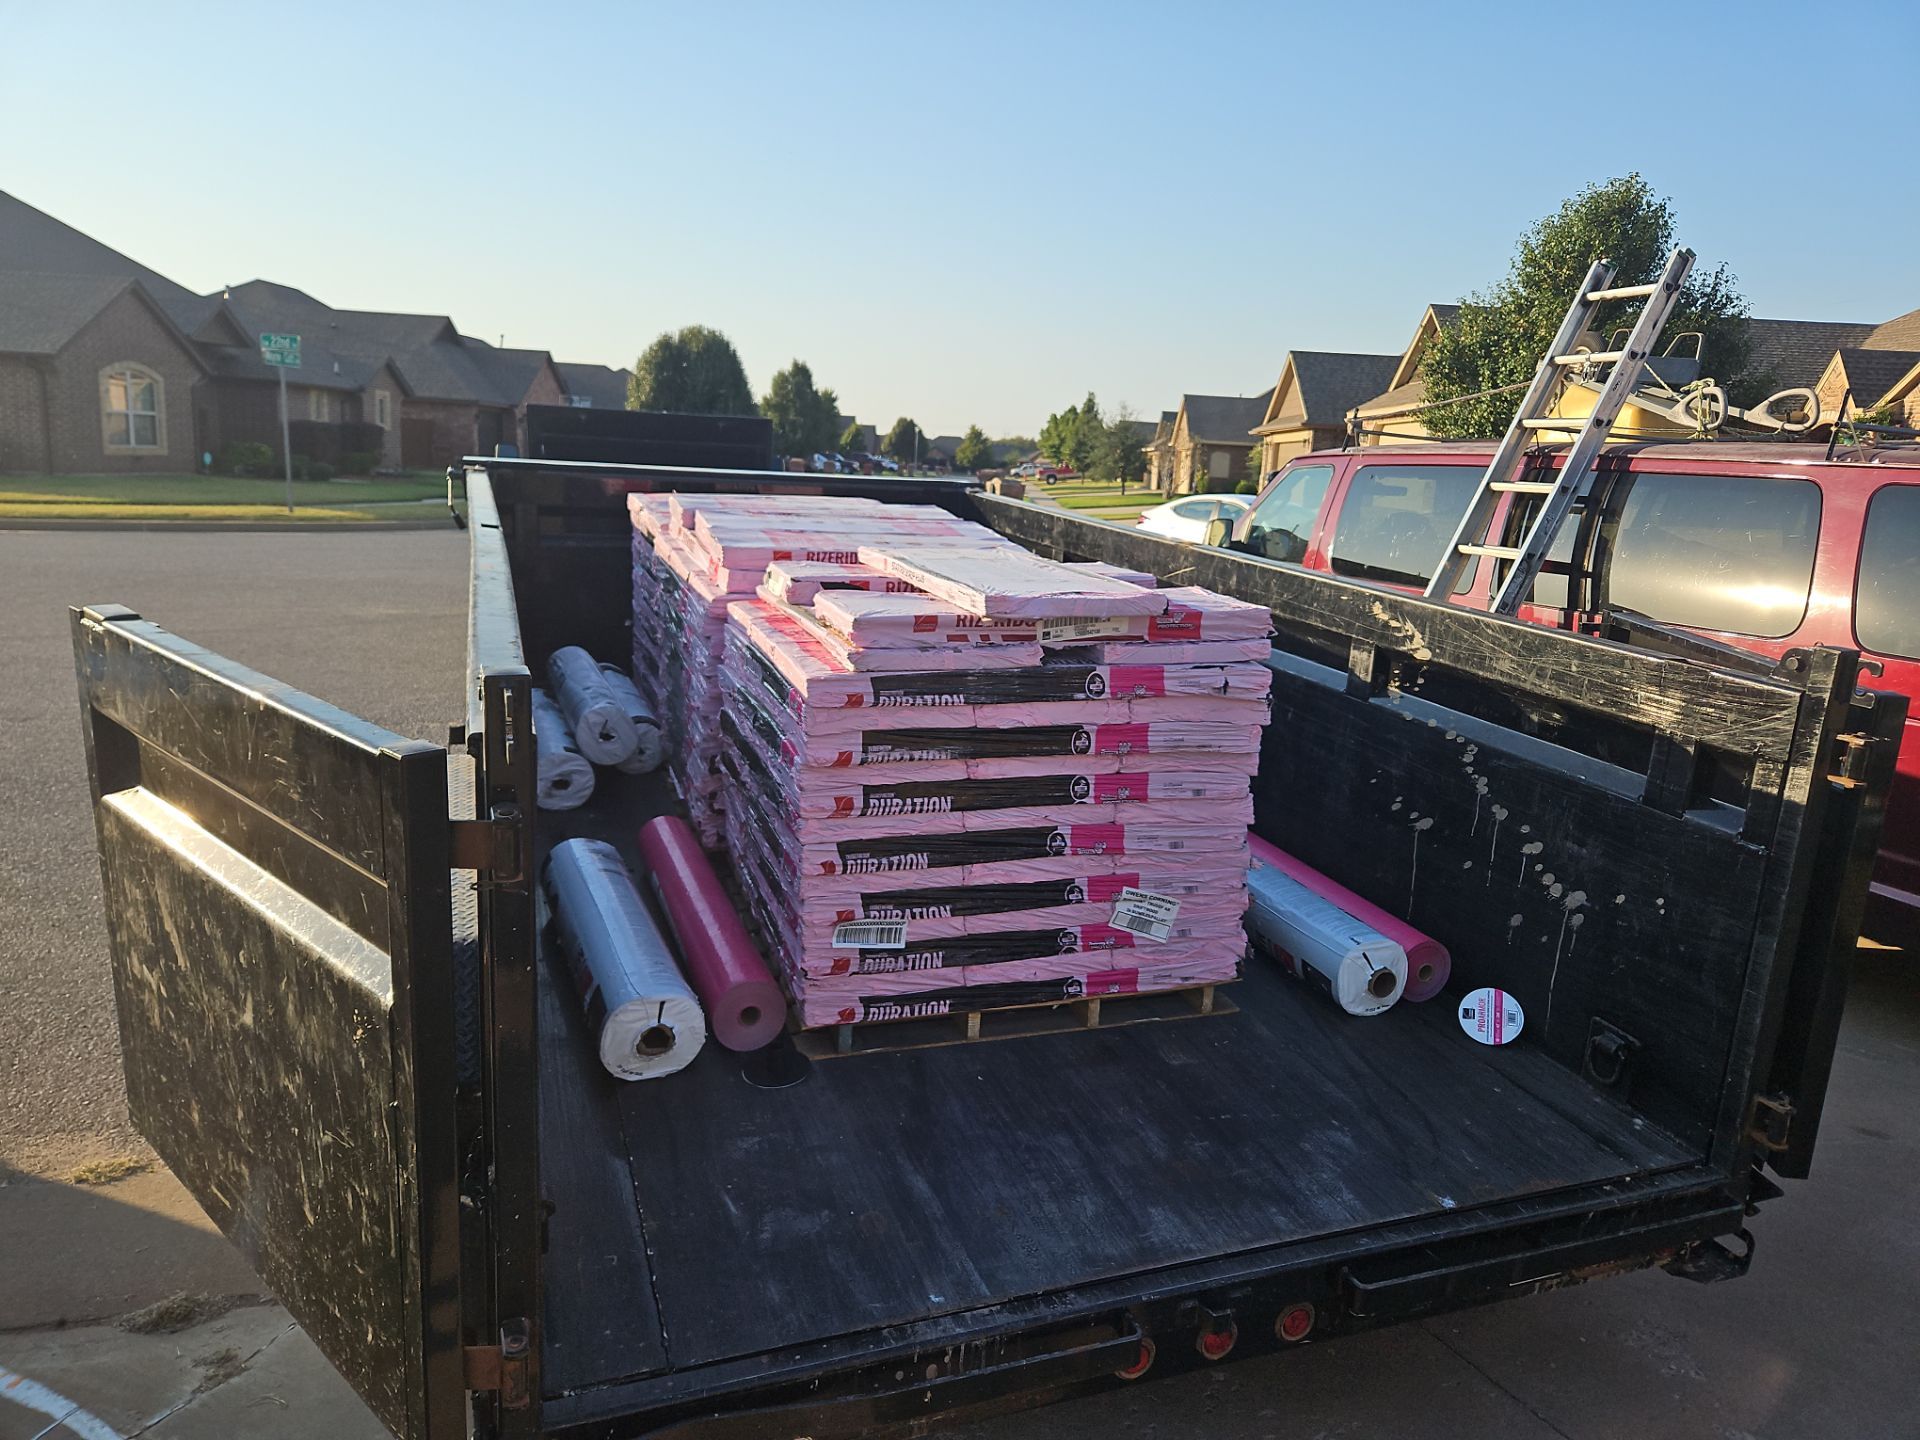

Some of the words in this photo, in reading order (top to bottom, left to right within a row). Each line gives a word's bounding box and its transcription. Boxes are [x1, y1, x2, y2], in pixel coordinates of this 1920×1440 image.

[867, 796, 952, 816] DURATION
[846, 853, 929, 874] DURATION
[1125, 889, 1149, 899] OWENS
[1148, 895, 1178, 906] CORNING
[863, 951, 943, 973] DURATION
[867, 999, 951, 1022] DURATION
